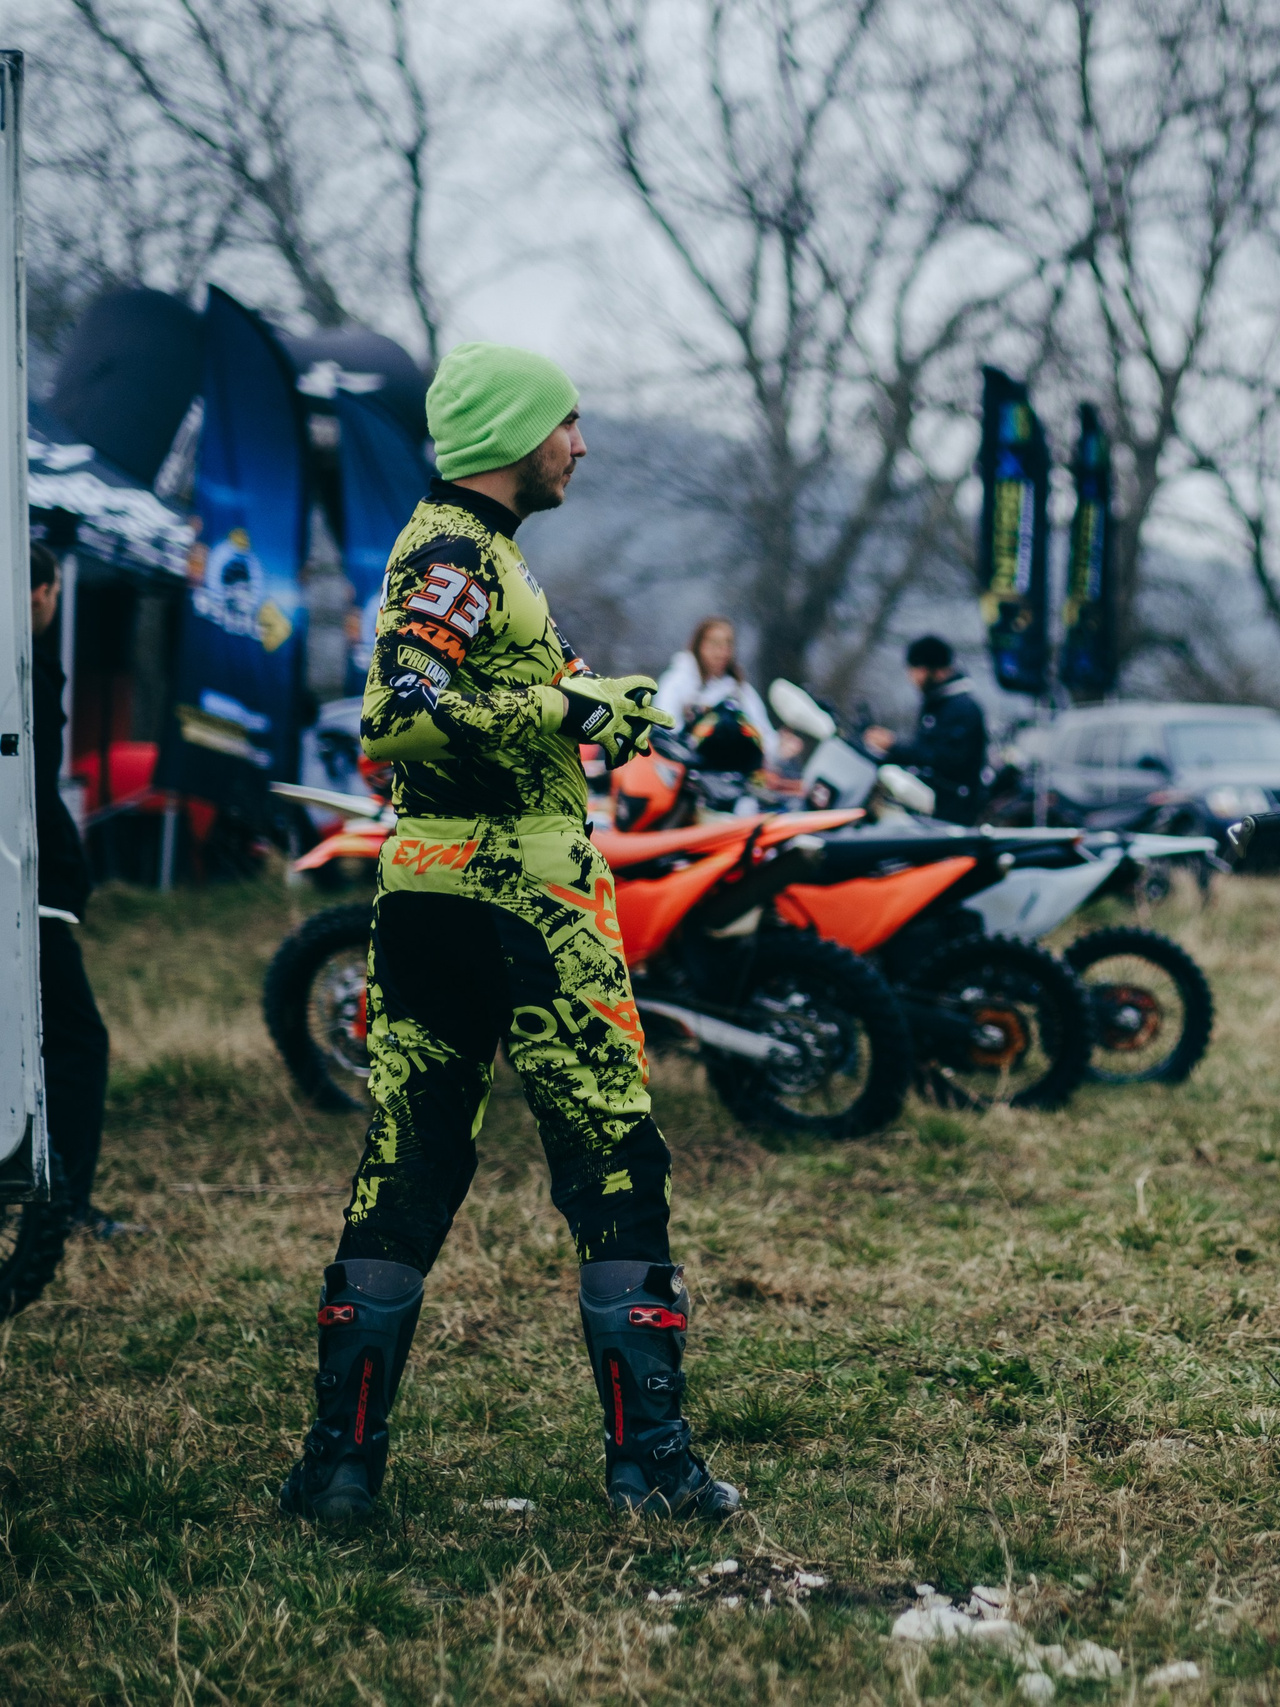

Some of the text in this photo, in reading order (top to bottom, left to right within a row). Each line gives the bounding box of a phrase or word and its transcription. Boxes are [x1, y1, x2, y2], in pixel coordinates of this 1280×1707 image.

[402, 563, 492, 638] 33
[397, 621, 467, 667] KTM
[400, 648, 451, 689] PROTAPE
